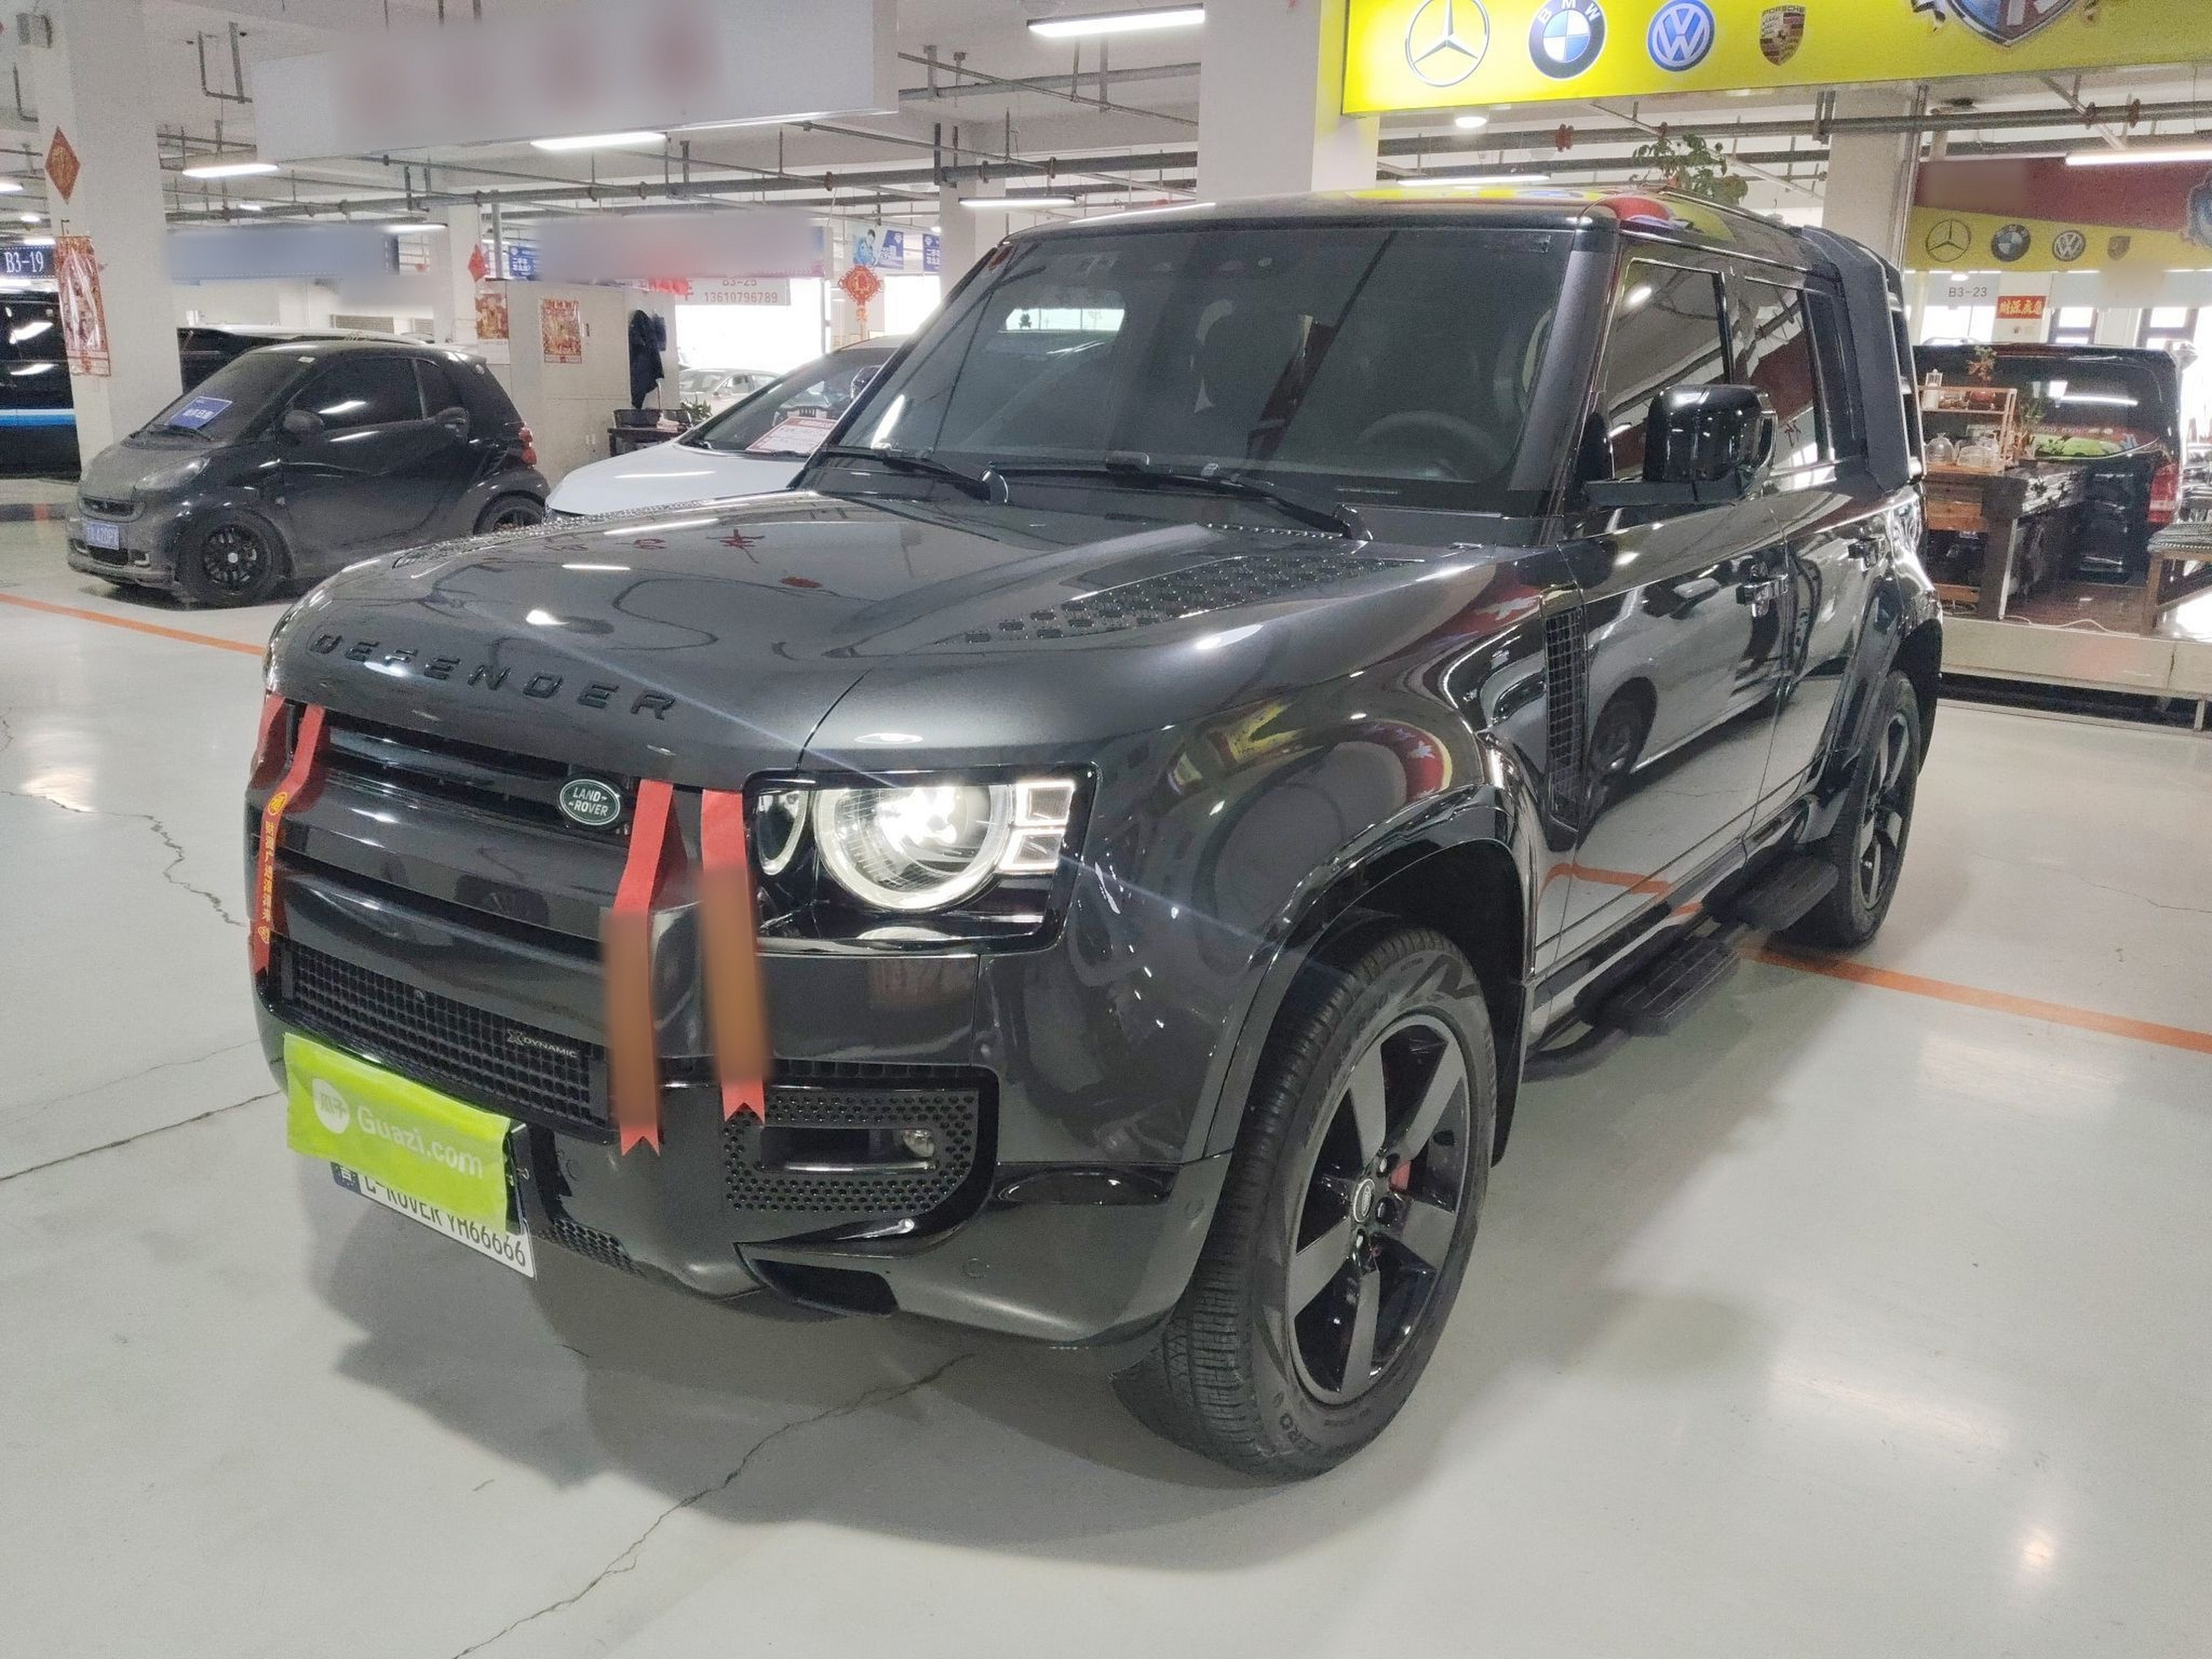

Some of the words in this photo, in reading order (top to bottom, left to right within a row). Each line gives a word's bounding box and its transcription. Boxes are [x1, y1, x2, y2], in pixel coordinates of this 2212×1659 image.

[4, 251, 44, 272] B3-19
[1949, 287, 1987, 298] B3-23
[309, 633, 676, 721] DEFENDER
[573, 787, 601, 802] LAND
[574, 800, 608, 816] ROVER
[357, 1105, 483, 1180] Guazi.com
